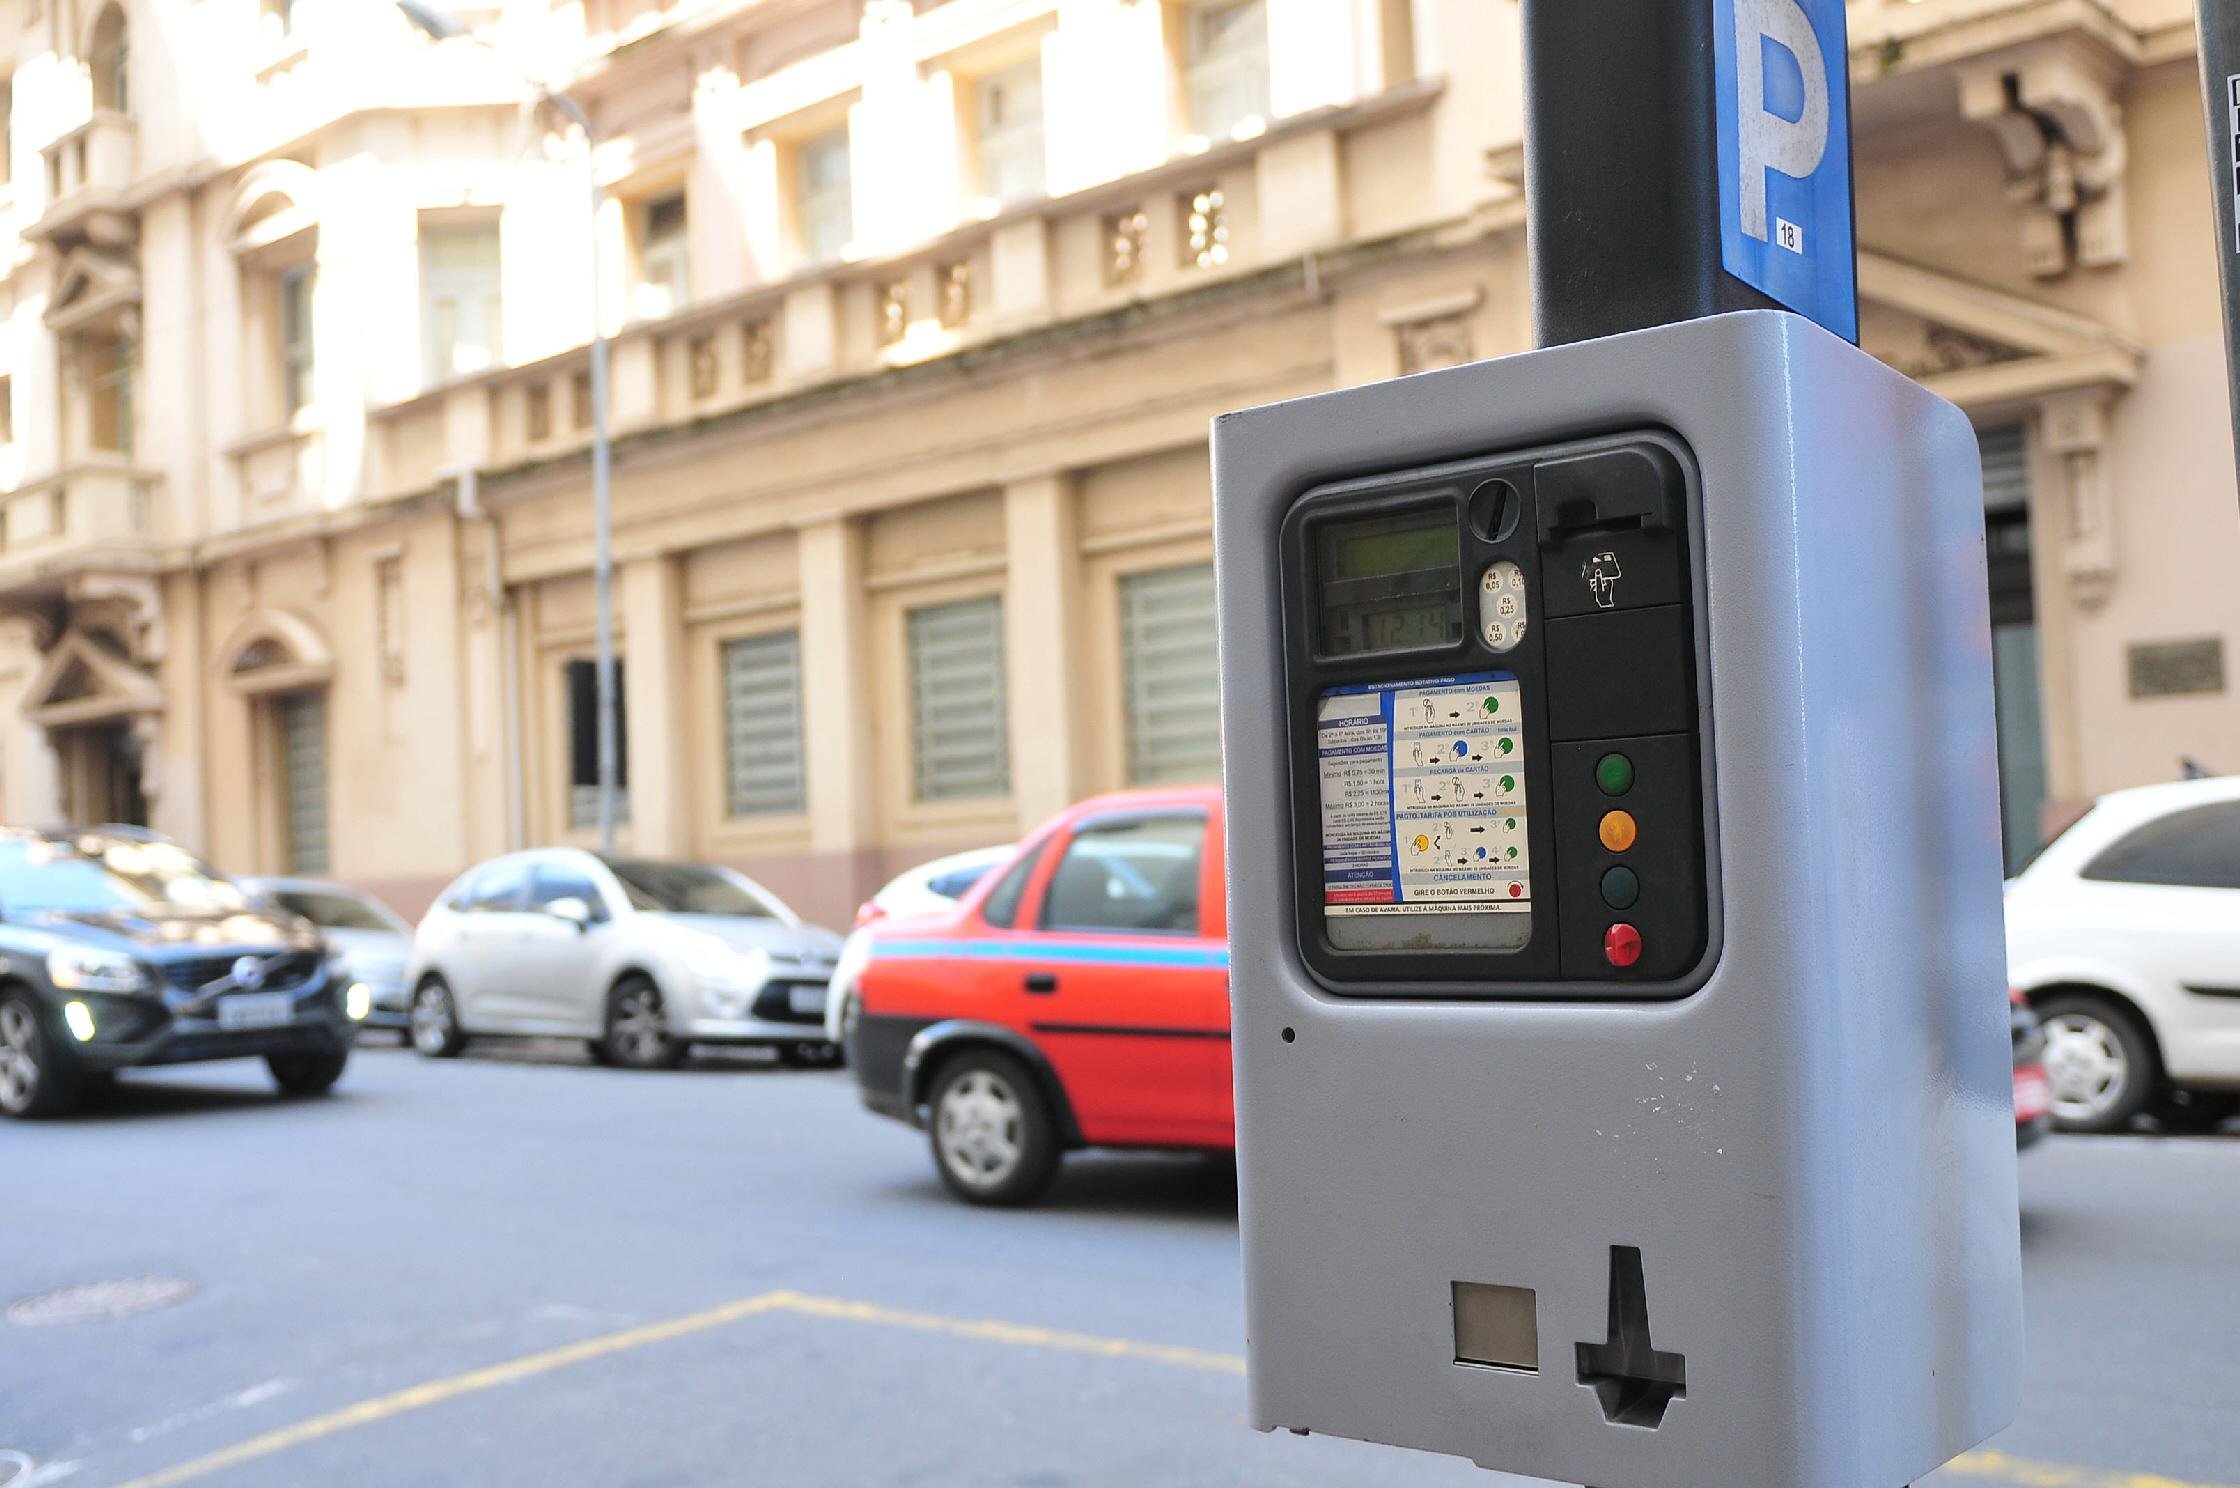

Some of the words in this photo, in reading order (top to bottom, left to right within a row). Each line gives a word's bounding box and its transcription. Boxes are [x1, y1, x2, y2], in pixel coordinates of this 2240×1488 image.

[1733, 0, 1829, 243] P
[1781, 222, 1794, 248] 18
[1488, 572, 1496, 580] R$
[1486, 581, 1499, 590] 0,05
[1502, 597, 1510, 605] R$
[1500, 606, 1514, 615] 0,25
[1489, 633, 1502, 642] 0,50
[1419, 687, 1453, 697] PAGAMENTO
[1467, 685, 1490, 693] MOEDAS
[1338, 717, 1368, 727] HORÁRIO
[1419, 730, 1453, 738] PAGAMENTO
[1466, 727, 1489, 735] CARTÃO
[1321, 748, 1353, 756] PAGAMENTO
[1465, 765, 1488, 773] CARTÃO
[1420, 811, 1442, 819] TARIFA
[1443, 809, 1456, 818] PÓS
[1458, 808, 1497, 817] UTILIZAÇÃO
[1348, 871, 1374, 879] ATENÇÃO
[1434, 873, 1491, 881] CANCELAMENTO
[1437, 887, 1458, 895] BOTÃO
[1429, 904, 1456, 912] MÁQUINA
